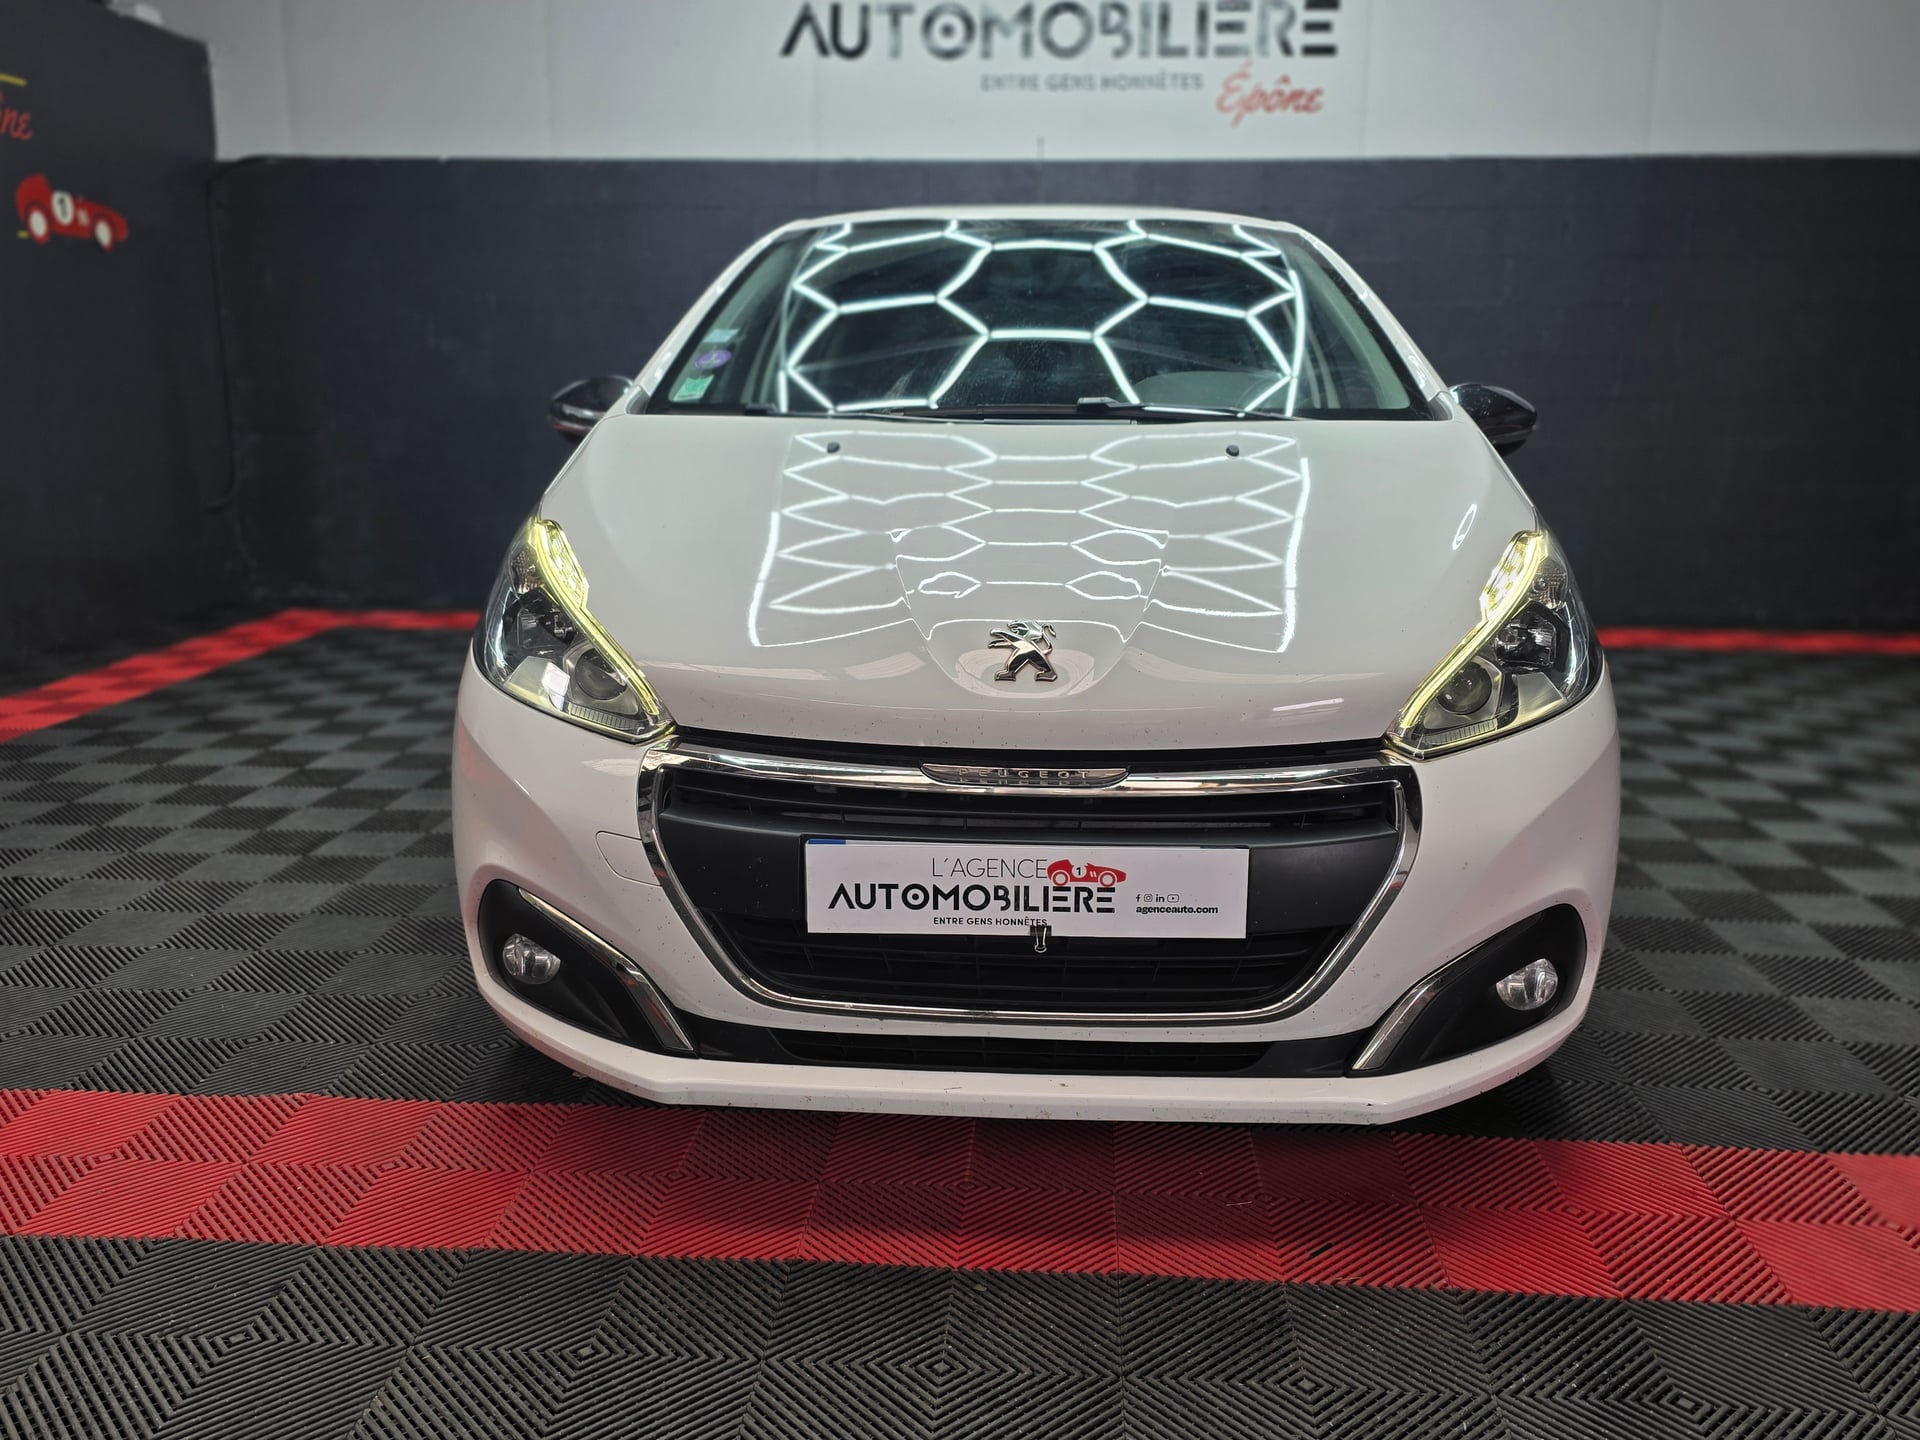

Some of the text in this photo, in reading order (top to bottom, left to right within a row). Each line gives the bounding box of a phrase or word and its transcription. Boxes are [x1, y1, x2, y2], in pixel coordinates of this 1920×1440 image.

[981, 69, 1203, 92] ENTRE GENS HONNÊTES
[1216, 57, 1324, 128] Épône
[0, 106, 34, 141] ne
[959, 768, 1090, 779] PEUGEOT
[932, 857, 1048, 879] L'AGENCE
[1076, 866, 1082, 876] 1
[828, 882, 1116, 913] AUTOMOBILIERE
[1136, 905, 1219, 914] agenceauto.com
[933, 915, 1048, 927] ENTRE GENS HONNÊTES
